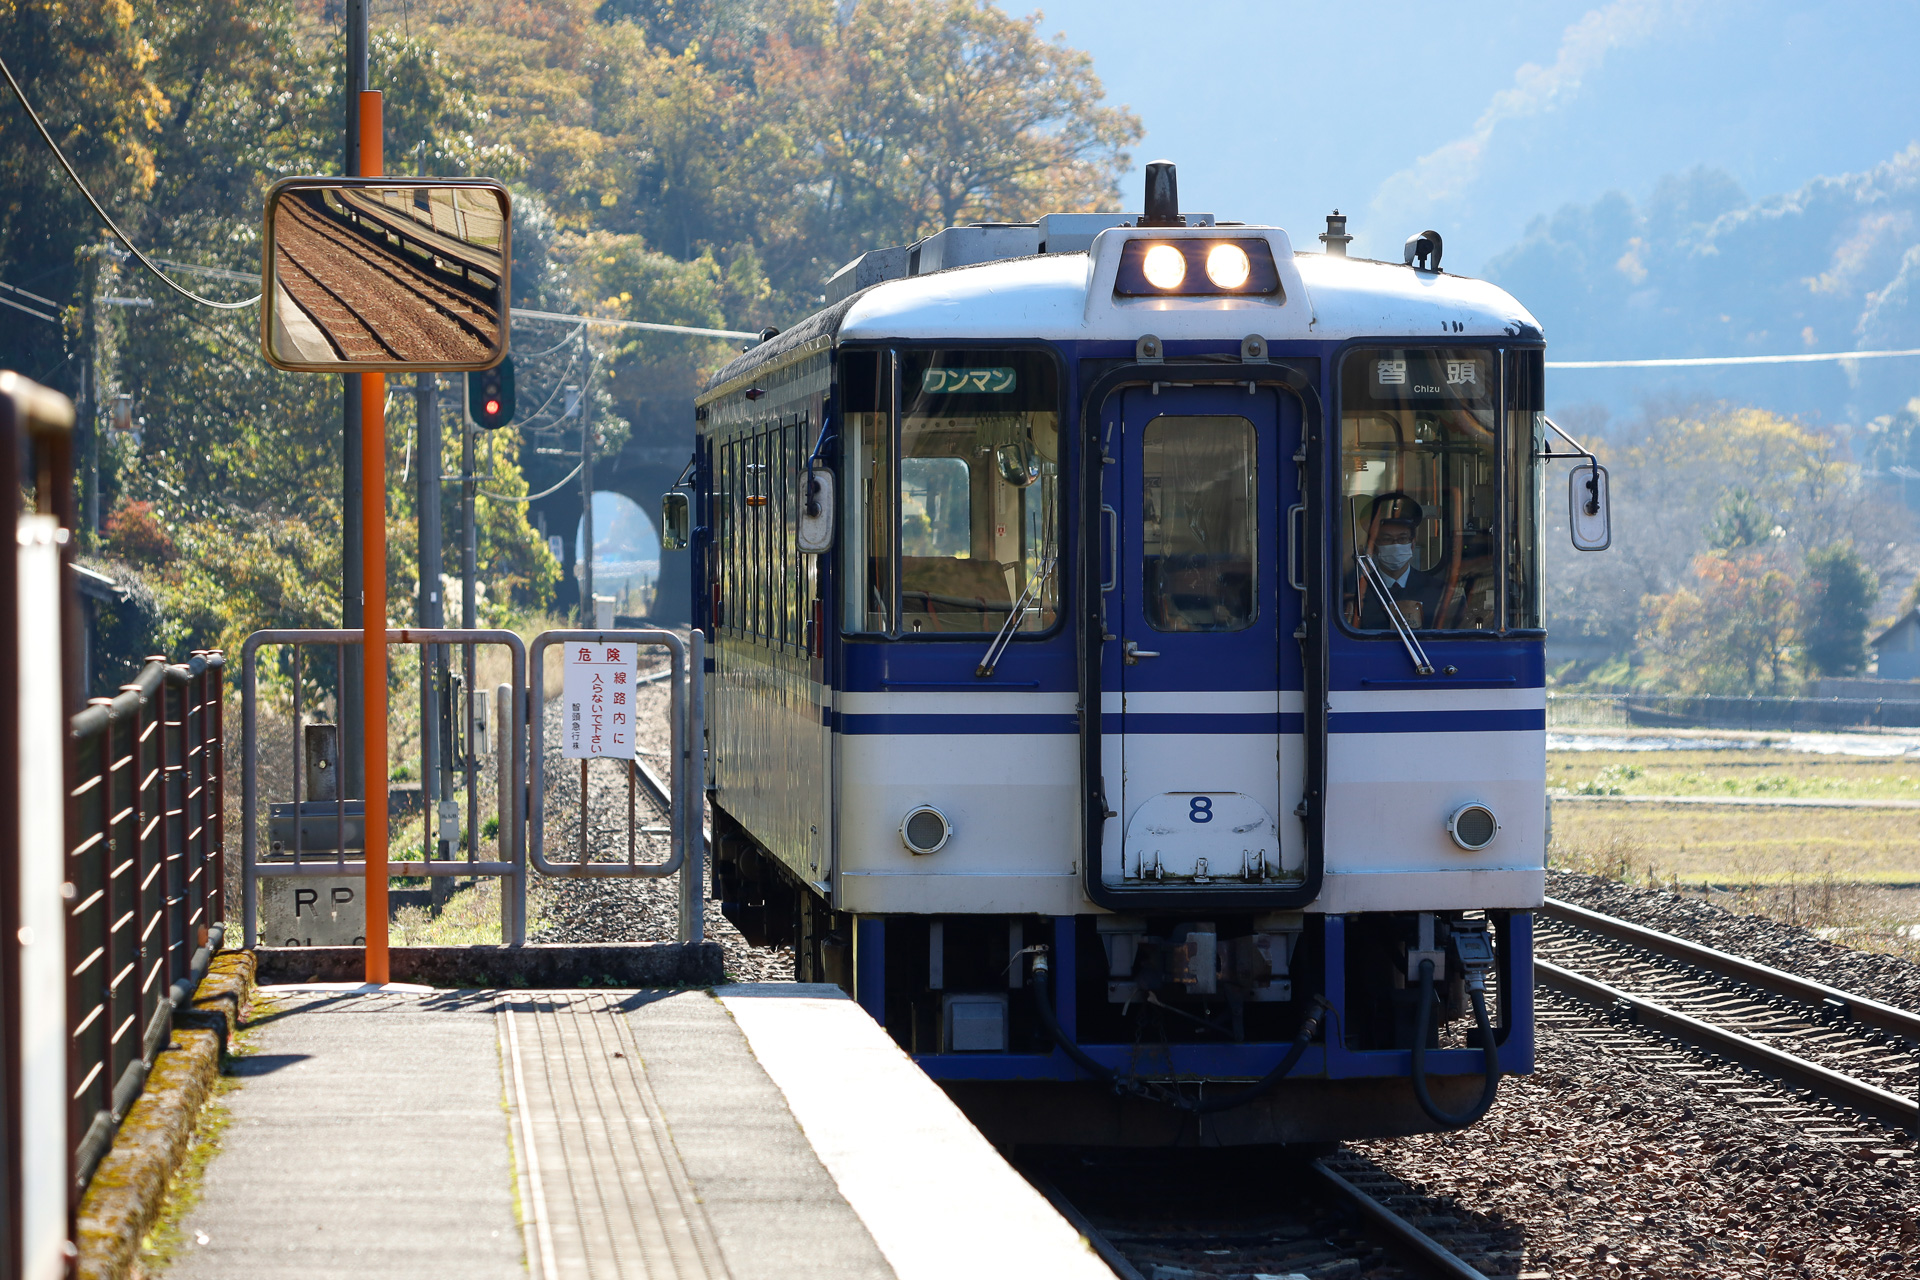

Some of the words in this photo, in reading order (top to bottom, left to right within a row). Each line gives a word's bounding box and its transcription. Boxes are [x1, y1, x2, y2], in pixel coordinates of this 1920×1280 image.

[926, 370, 1013, 392] ワンマン
[1377, 360, 1476, 385] 智頭
[1413, 385, 1440, 393] Chizu
[577, 647, 621, 662] 危険
[590, 673, 604, 753] 入らないで下さい
[613, 671, 627, 744] 線路内に
[1189, 796, 1213, 824] 8
